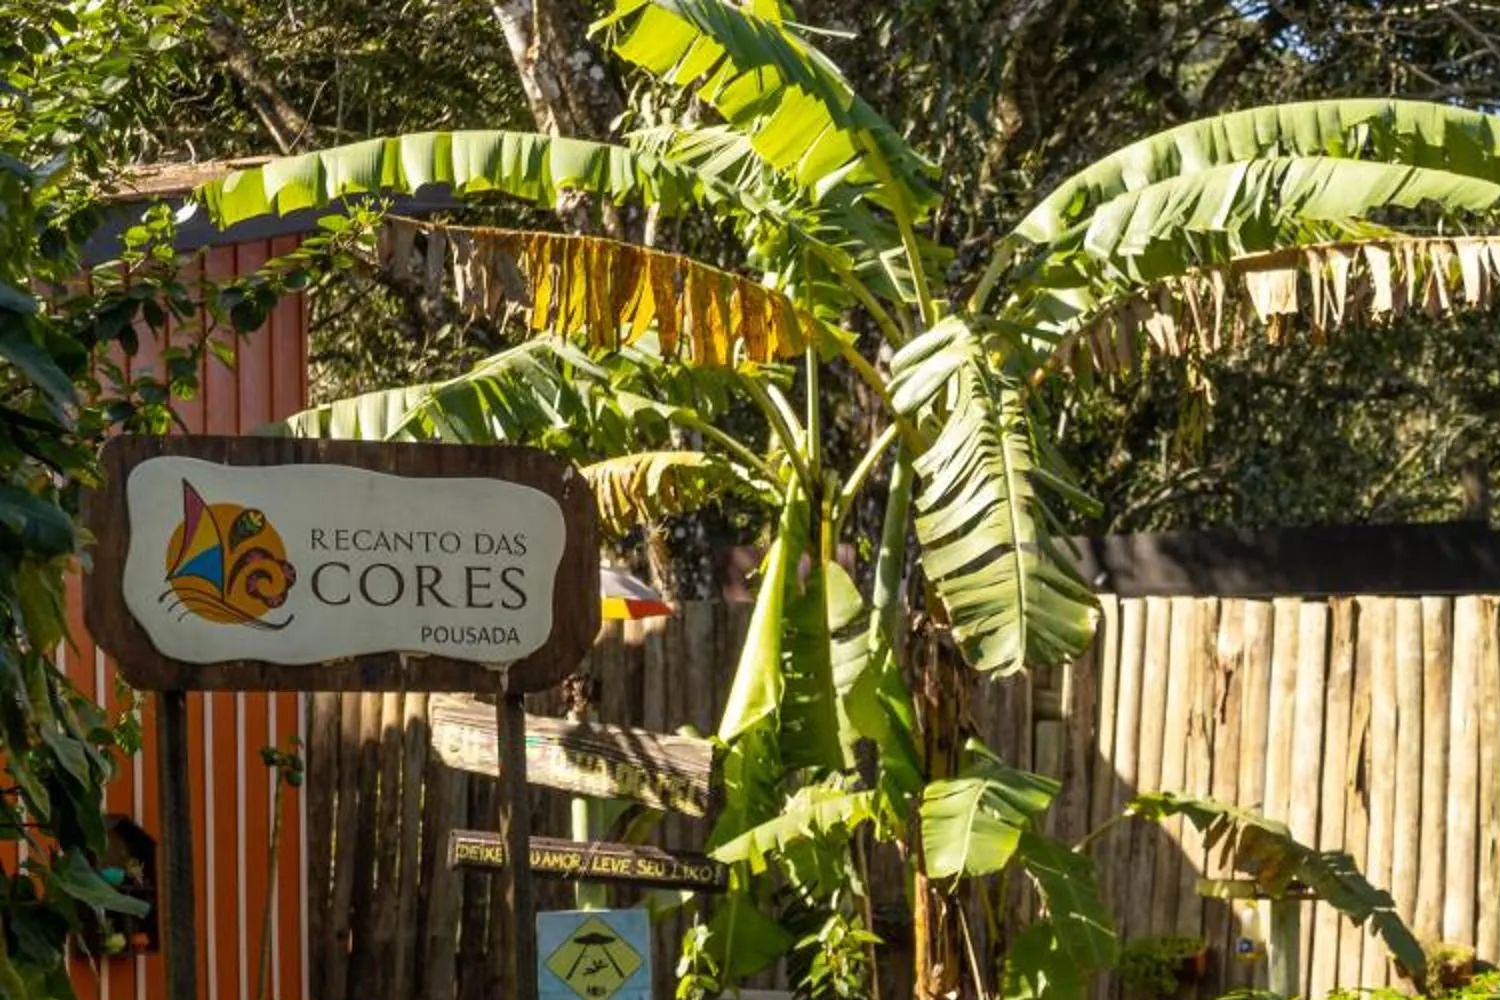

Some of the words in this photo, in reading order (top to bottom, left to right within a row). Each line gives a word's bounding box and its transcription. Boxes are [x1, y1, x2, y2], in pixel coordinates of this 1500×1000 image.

[311, 528, 462, 556] RECANTO
[474, 533, 528, 556] DAS
[311, 562, 528, 610] CORES
[420, 625, 521, 645] POUSADA
[456, 844, 503, 863] DEIXE
[591, 855, 631, 875] LEVE
[637, 858, 666, 878] SEU
